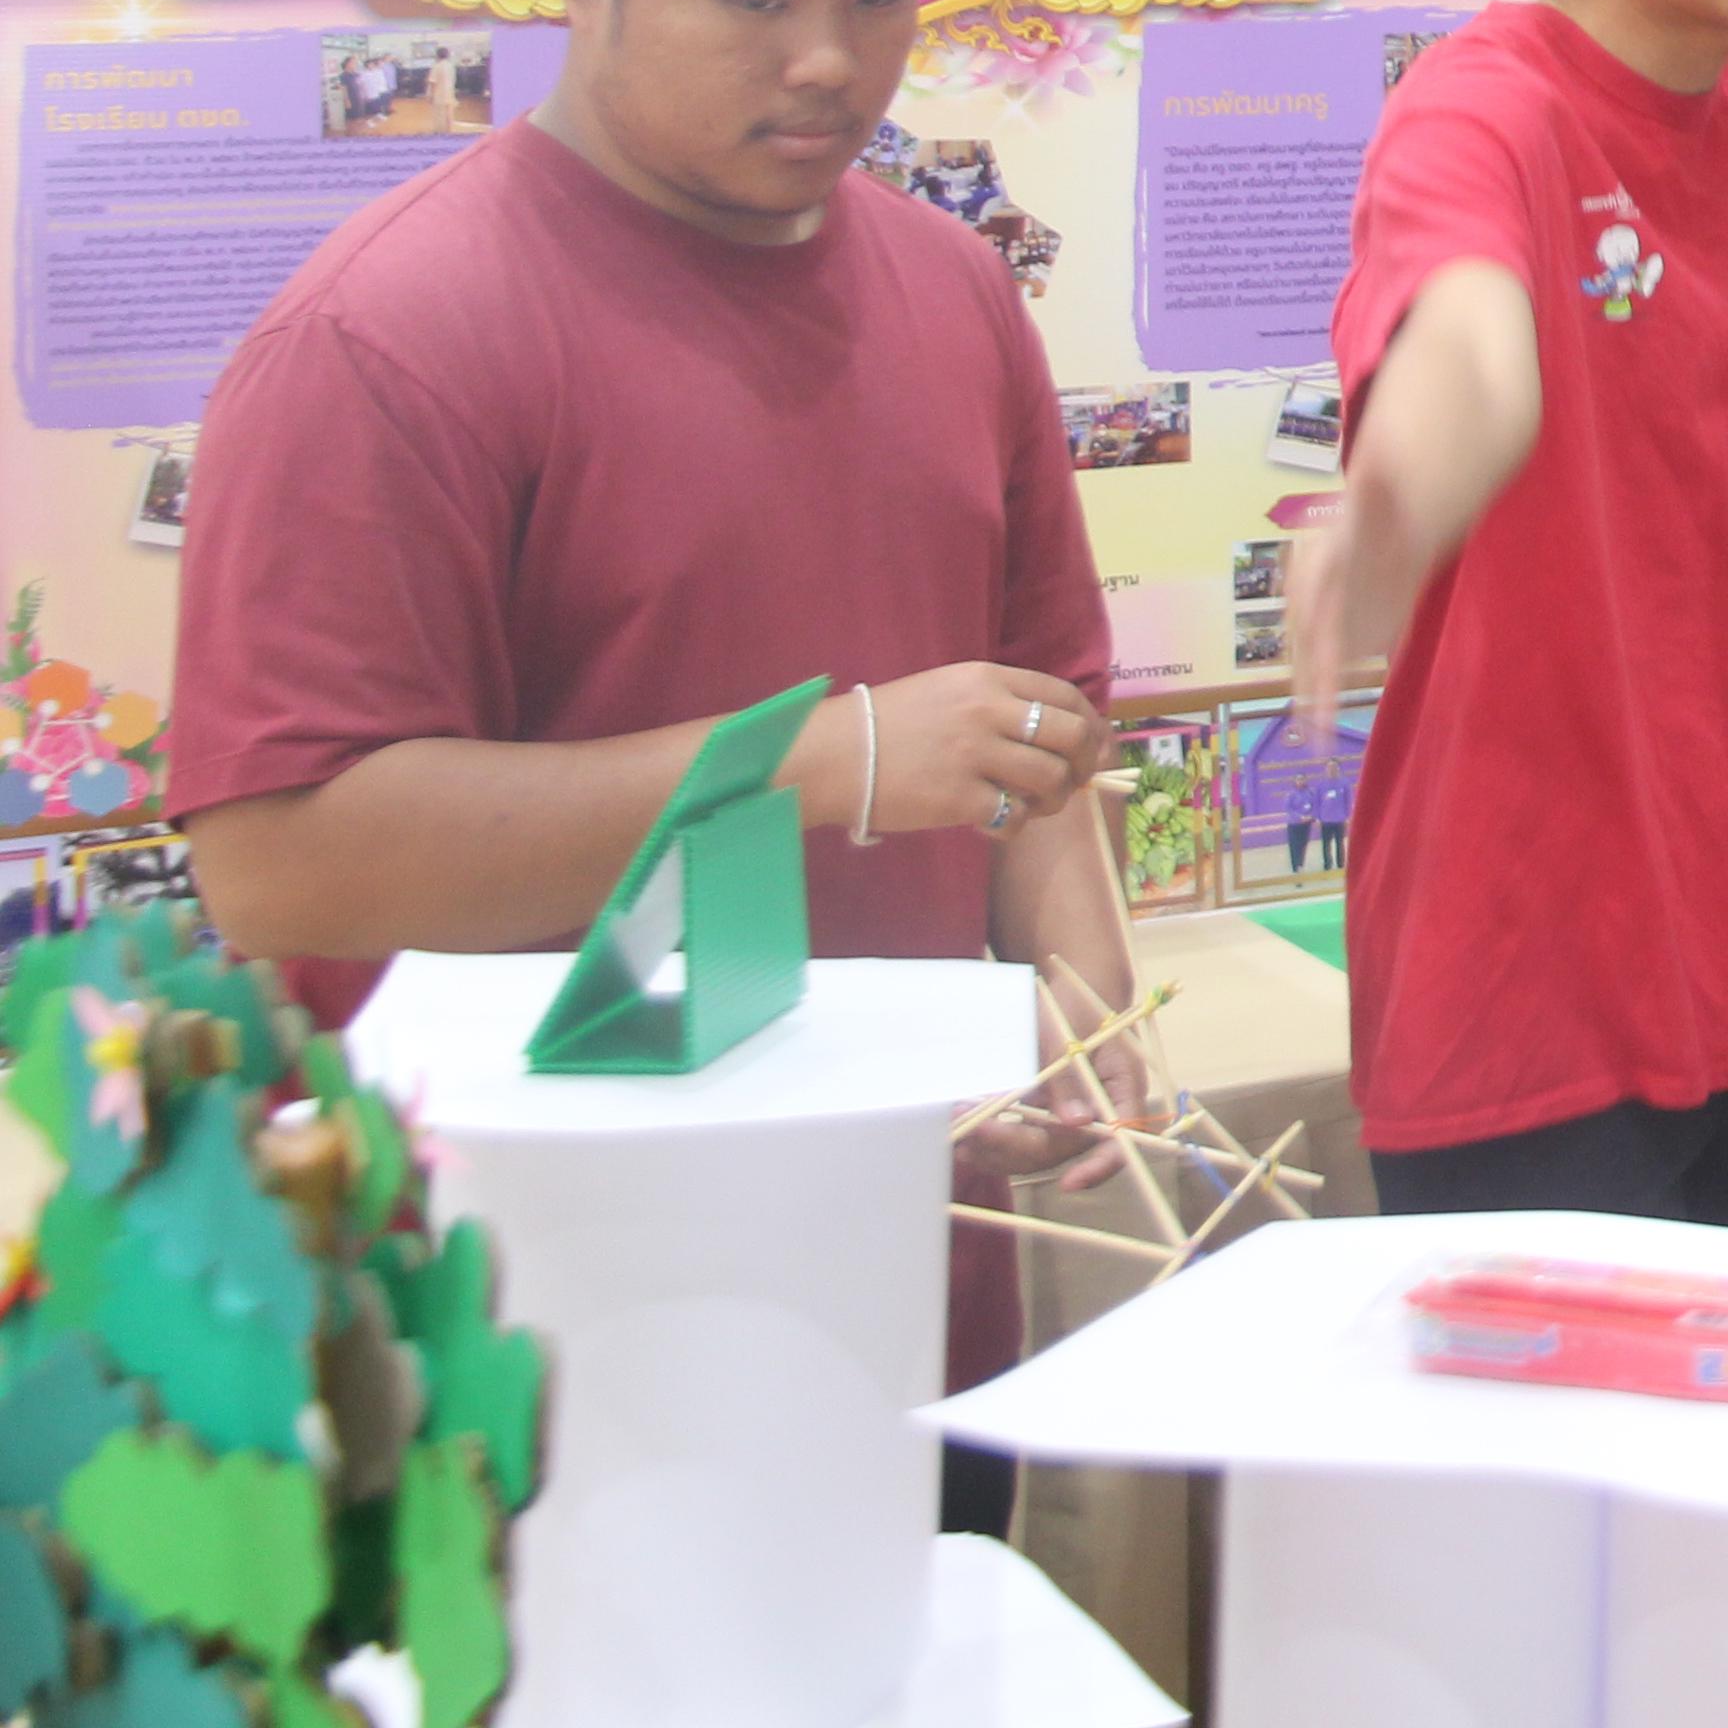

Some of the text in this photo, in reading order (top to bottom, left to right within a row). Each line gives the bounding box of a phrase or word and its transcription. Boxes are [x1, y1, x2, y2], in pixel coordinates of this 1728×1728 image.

[1164, 89, 1329, 120] การพัฒนาครู
